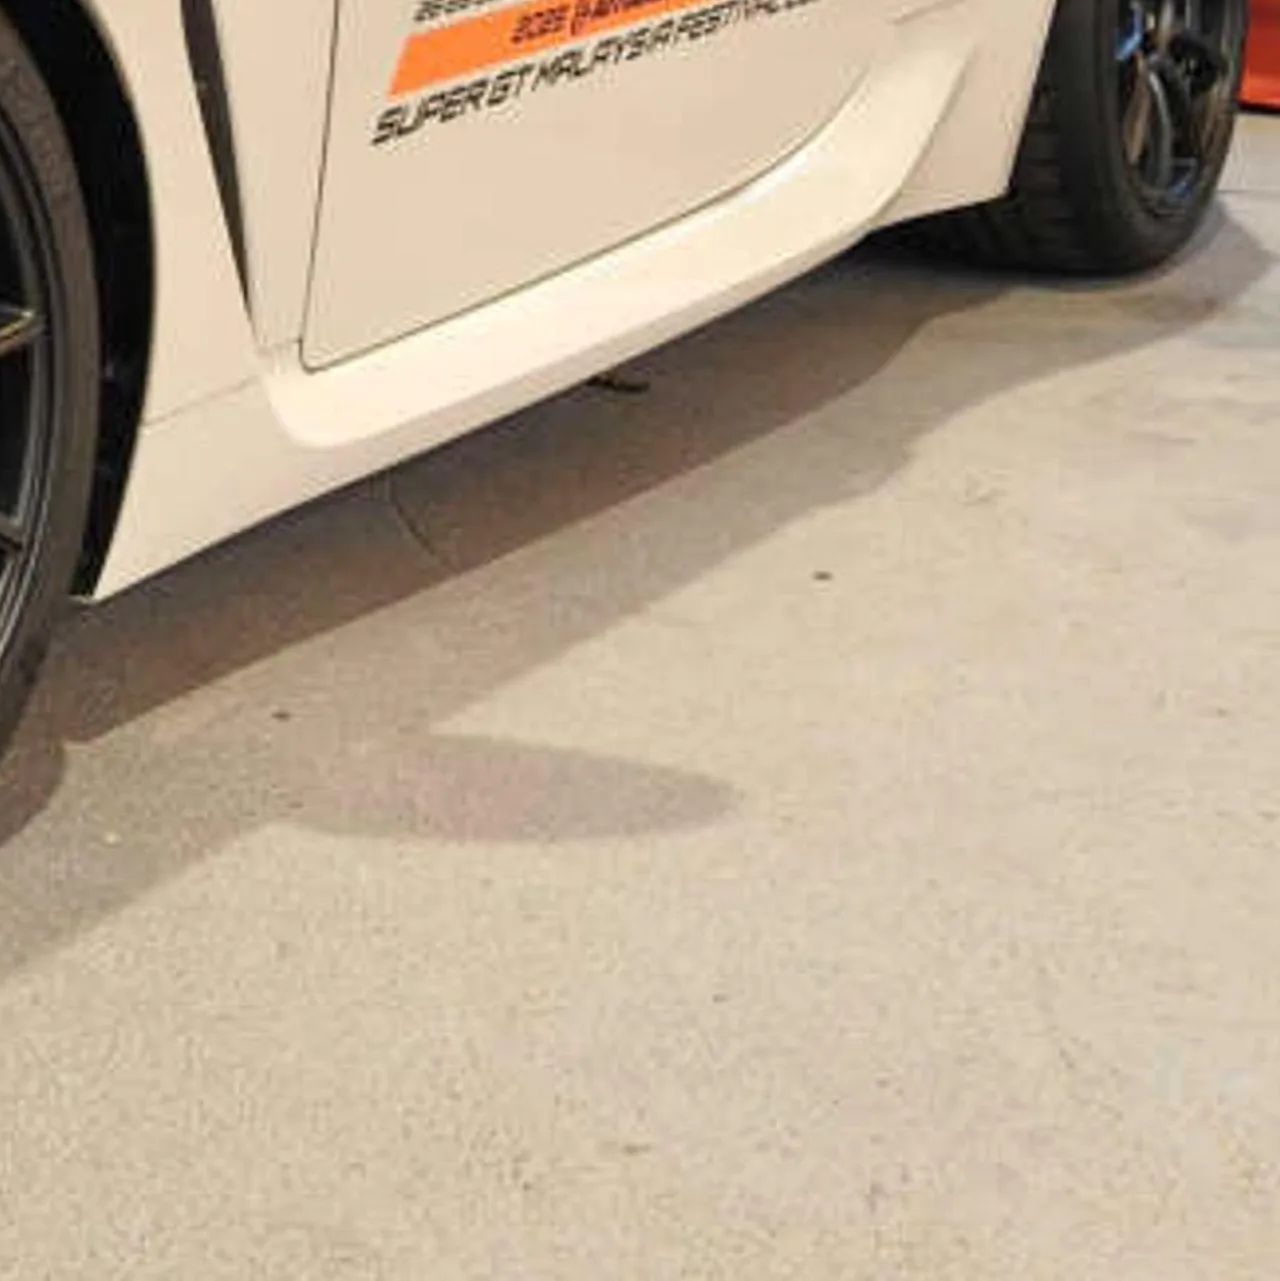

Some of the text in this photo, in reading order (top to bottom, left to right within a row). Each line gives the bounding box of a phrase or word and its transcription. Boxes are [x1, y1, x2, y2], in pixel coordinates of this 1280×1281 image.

[372, 78, 490, 144] SUPER
[487, 63, 537, 107] GT
[531, 20, 675, 93] MALAYSIA
